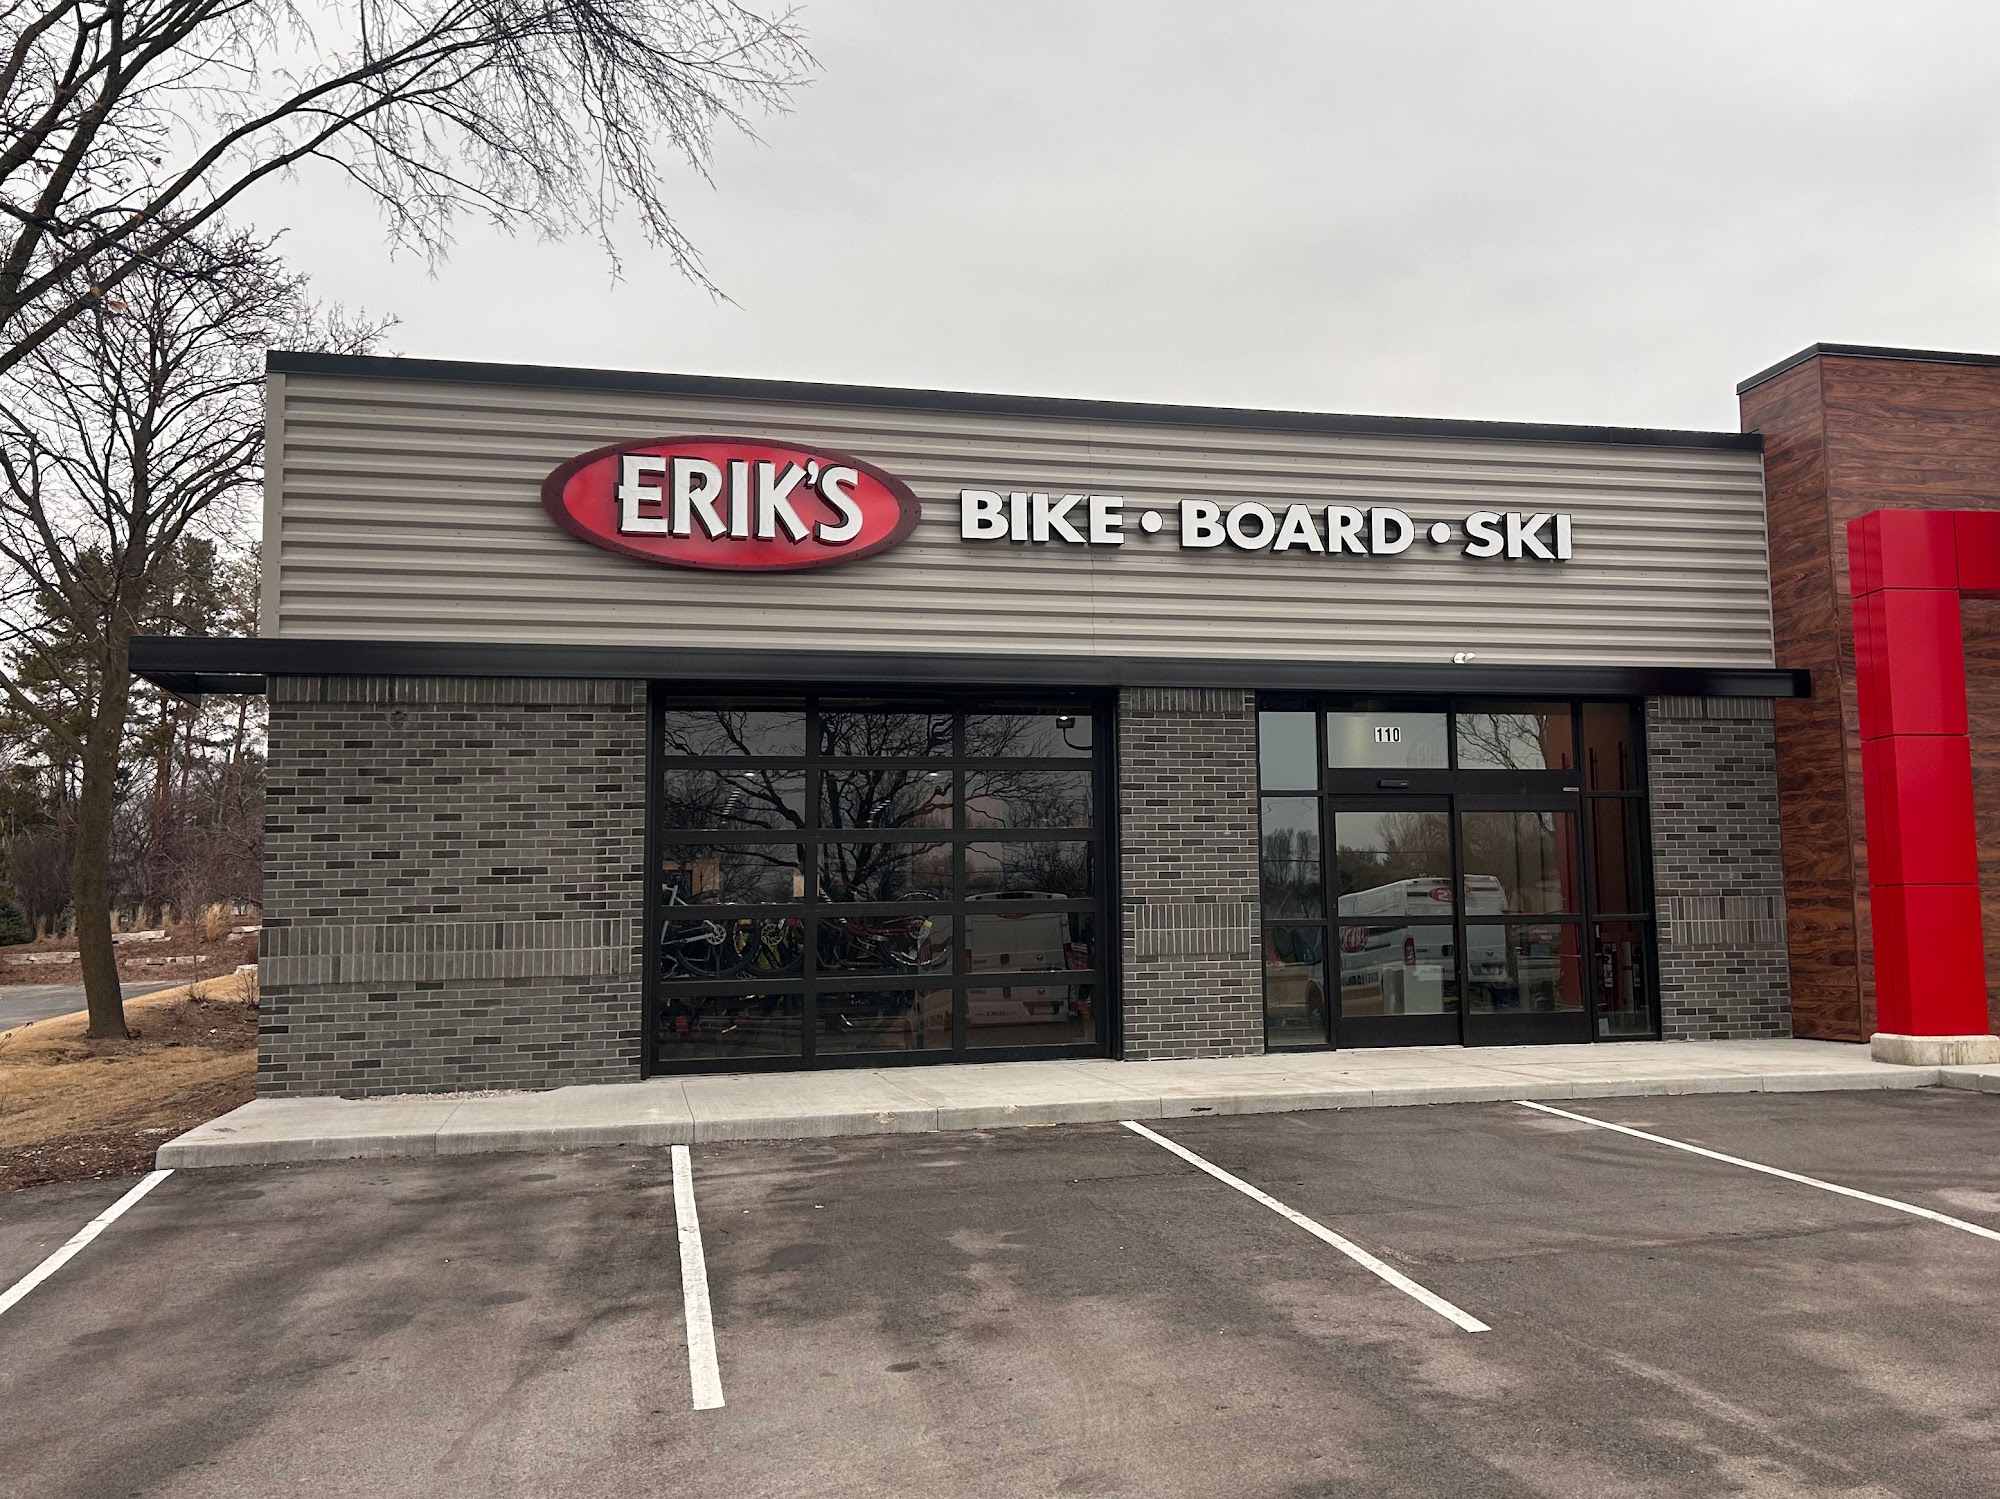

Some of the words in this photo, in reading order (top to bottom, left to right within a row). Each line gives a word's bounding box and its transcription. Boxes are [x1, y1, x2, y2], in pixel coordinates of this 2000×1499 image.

[617, 453, 864, 543] ERIK'S
[960, 488, 1125, 545] BIKE
[1180, 498, 1416, 557] BOARD
[1462, 511, 1573, 561] SKI
[1376, 727, 1400, 742] 110
